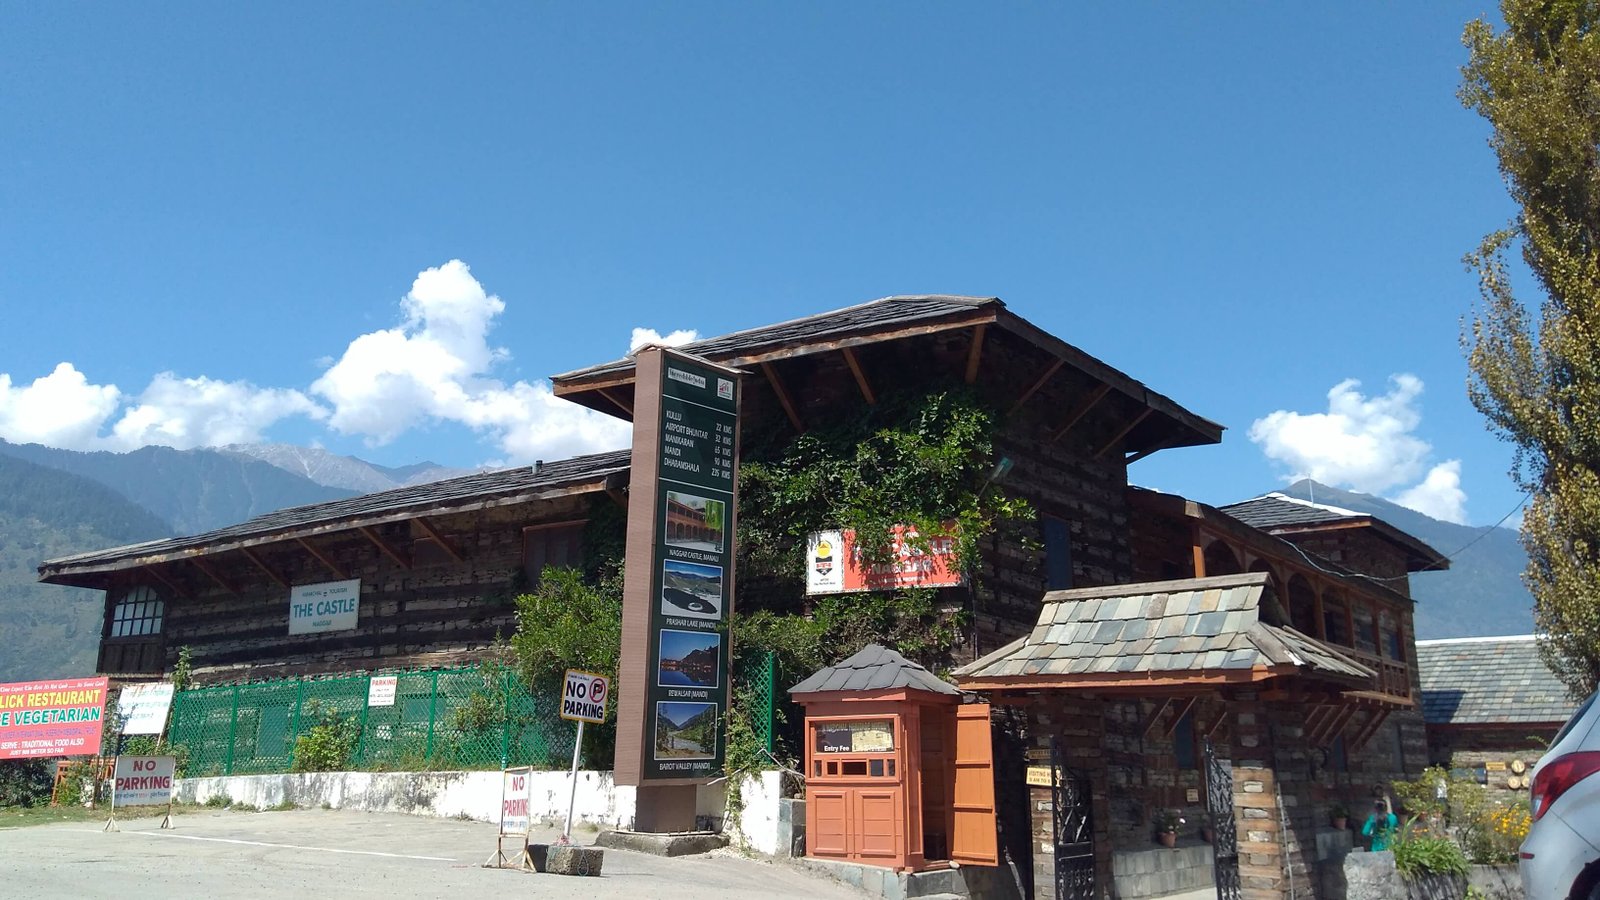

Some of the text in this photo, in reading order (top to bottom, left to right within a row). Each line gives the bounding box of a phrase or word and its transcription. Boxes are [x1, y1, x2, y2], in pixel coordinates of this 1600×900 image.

[666, 410, 732, 434] KULLU 22 KMS
[665, 422, 686, 435] AIRPORT
[685, 426, 709, 440] BHUNTAR
[722, 437, 732, 446] KMS
[665, 433, 695, 448] MANIKARAN
[722, 448, 731, 457] KMS
[664, 445, 681, 457] MANDI
[722, 459, 731, 468] KMS
[664, 457, 700, 473] DHARAMSHALA
[721, 470, 731, 480] KMS
[669, 549, 688, 558] NAGGAR
[703, 554, 719, 562] MANALI
[293, 598, 355, 618] THE CASTLE
[666, 618, 687, 626] PRASHAR
[698, 621, 717, 629] (MANDI
[27, 689, 101, 707] RESTAURANT
[566, 680, 586, 698] NO
[690, 690, 708, 699] (MANDI)
[0, 706, 101, 726] E VEGETARIAN
[563, 700, 604, 719] PARKING
[21, 739, 54, 748] TRADITIONAL
[54, 738, 70, 747] FOOD
[70, 737, 84, 746] ALSO
[9, 748, 22, 756] JUST
[133, 760, 156, 772] NO
[659, 762, 710, 771] BAROT VALLEY (MANDI)
[115, 776, 170, 791] PARKING
[512, 776, 525, 791] NO
